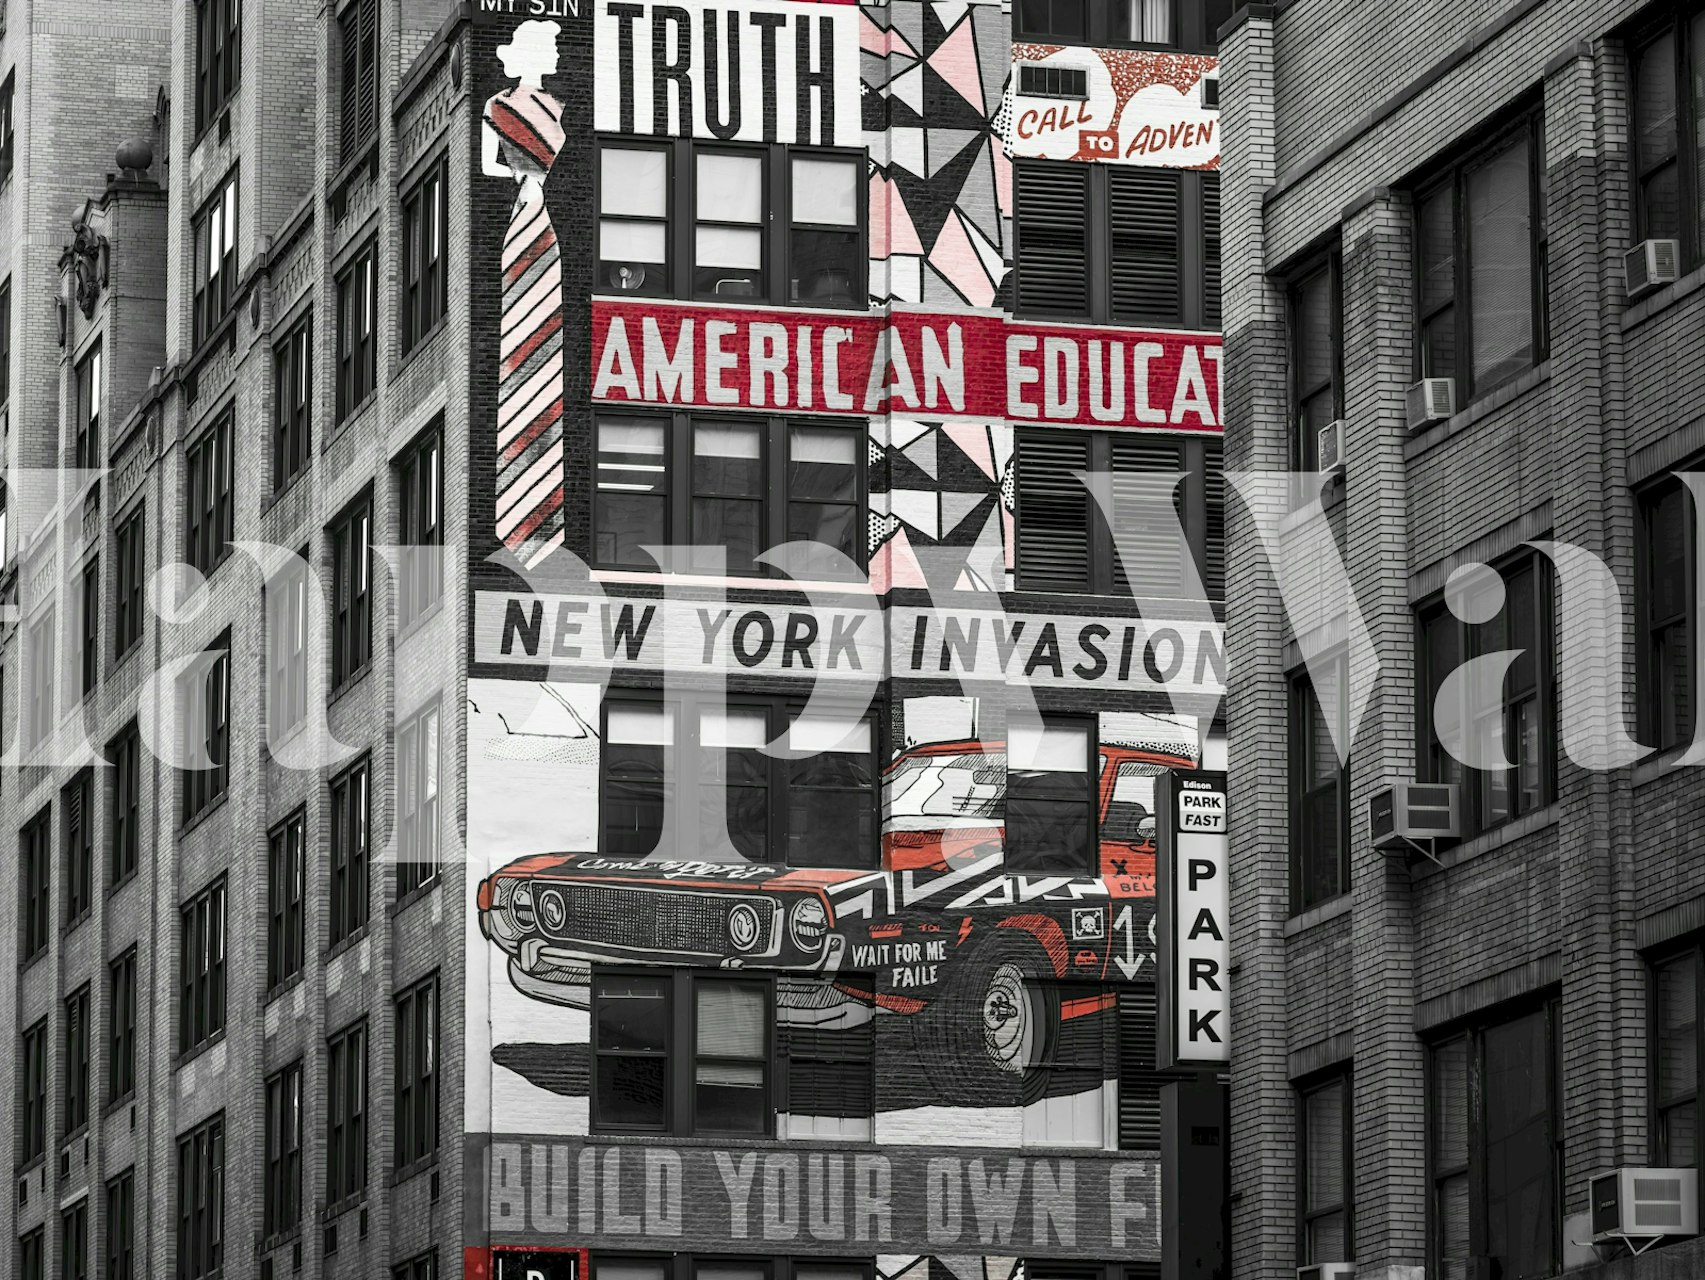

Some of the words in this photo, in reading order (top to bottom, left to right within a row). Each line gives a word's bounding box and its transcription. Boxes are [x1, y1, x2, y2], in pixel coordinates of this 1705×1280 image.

[530, 0, 579, 17] SIN
[607, 3, 835, 146] TRUTH
[1017, 99, 1093, 139] CALL
[1086, 136, 1114, 152] TO
[1126, 119, 1220, 158] ADVEN
[592, 316, 966, 413] AMERICAN
[500, 599, 656, 661] NEW
[696, 608, 866, 670] YORK
[911, 615, 1226, 685] INVASION
[1183, 780, 1212, 790] Edison
[1184, 796, 1221, 808] PARK
[1185, 814, 1221, 827] FAST
[1120, 882, 1156, 892] BEL
[852, 944, 890, 967] WAIT
[895, 943, 922, 963] FOR
[926, 940, 947, 961] ME
[1187, 858, 1224, 1043] PARK
[892, 965, 938, 987] FAILE
[483, 1143, 683, 1236] BUILD
[713, 1151, 892, 1242] YOUR
[926, 1156, 1076, 1247] OWN
[1110, 1163, 1161, 1248] F
